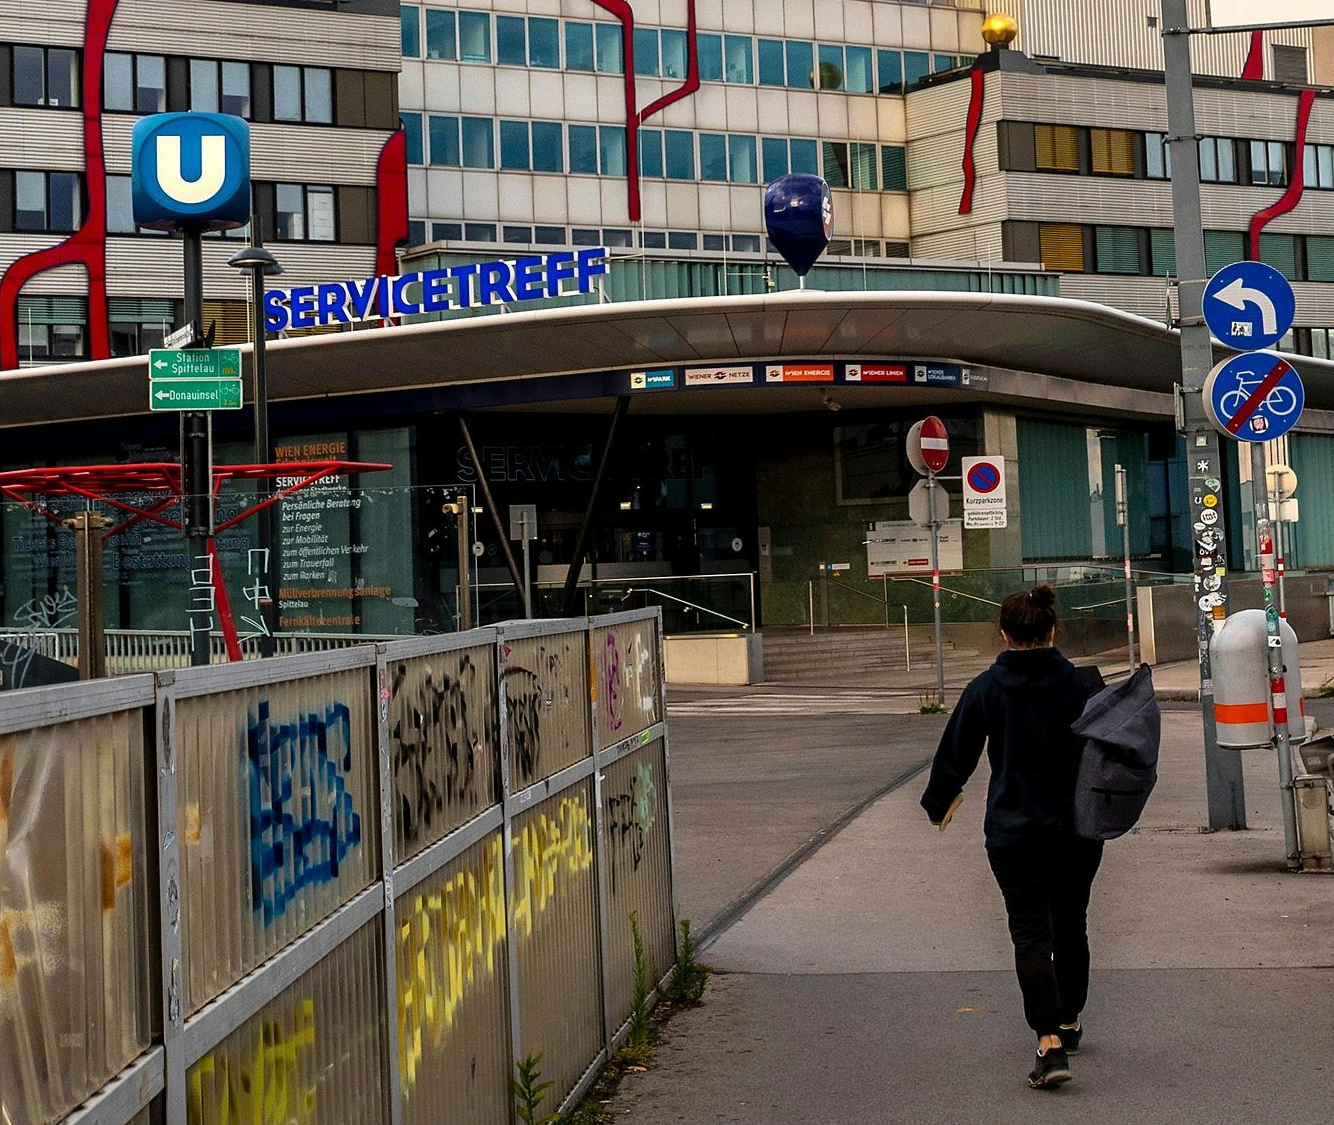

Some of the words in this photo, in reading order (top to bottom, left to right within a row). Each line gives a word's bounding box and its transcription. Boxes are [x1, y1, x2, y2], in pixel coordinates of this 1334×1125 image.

[156, 135, 226, 204] U
[266, 246, 611, 333] SERVICETREFF
[176, 352, 210, 363] Station
[171, 363, 215, 375] Spittelau
[803, 368, 831, 376] ENERGIE
[169, 390, 219, 400] Donauinsel
[275, 446, 301, 458] WIEN
[303, 442, 347, 455] ENERGIE
[282, 499, 326, 511] Persönliche
[282, 512, 295, 522] bei
[295, 511, 321, 522] Fragen
[282, 525, 294, 534] zur
[295, 522, 323, 534] Energie
[282, 537, 294, 546] zur
[295, 534, 329, 545] Mobilität
[282, 549, 298, 557] zum
[298, 546, 340, 558] öffentlichen
[340, 544, 370, 555] Verkehr
[282, 560, 298, 569] zum
[299, 558, 335, 569] Trauerfall
[283, 572, 299, 581] zum
[278, 585, 392, 599] Müllverbrennungsanlage
[278, 599, 309, 609] Spittelau
